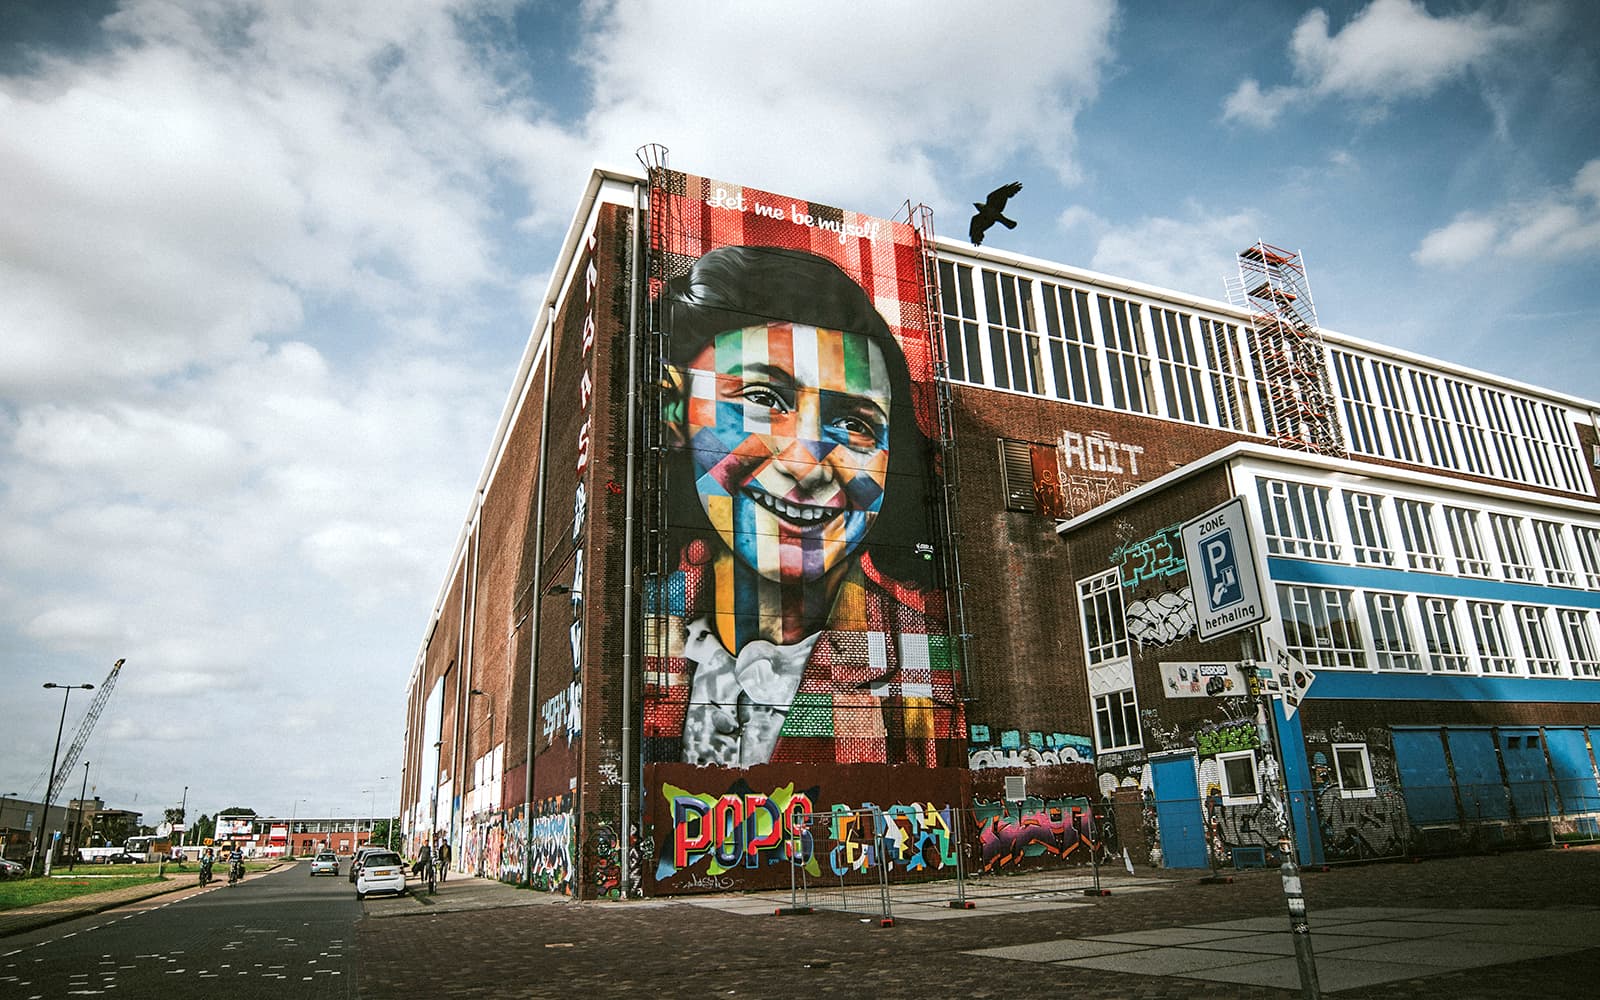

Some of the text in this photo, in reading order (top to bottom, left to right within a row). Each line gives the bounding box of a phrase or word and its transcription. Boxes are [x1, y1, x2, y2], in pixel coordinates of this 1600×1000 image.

[706, 188, 880, 247] Let me be myself
[1198, 514, 1226, 535] ZONE
[1207, 540, 1226, 579] P
[1205, 605, 1256, 630] herhaling
[673, 792, 814, 870] POPS
